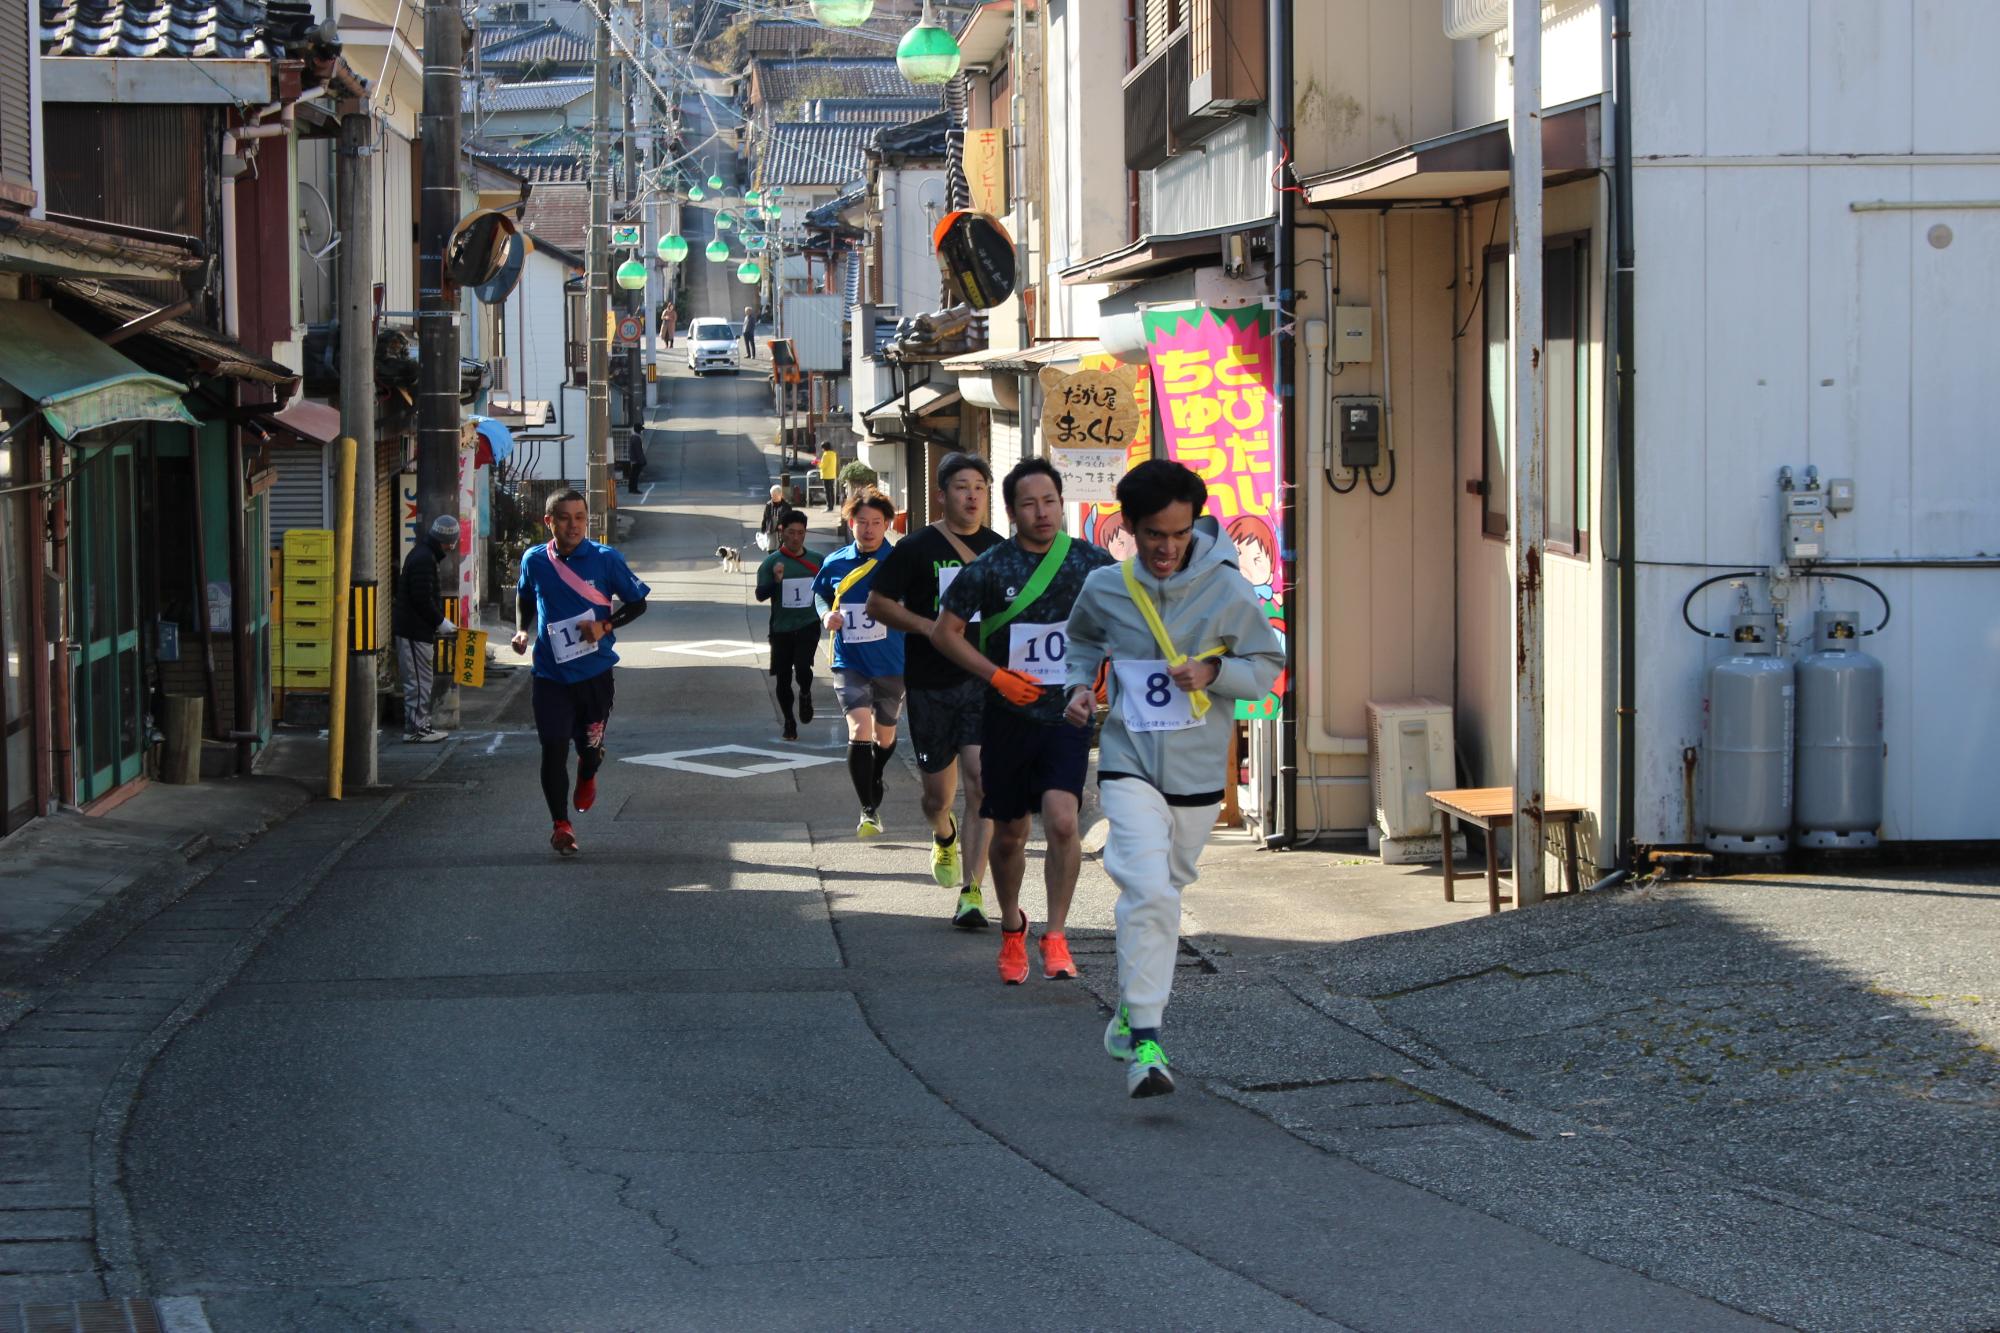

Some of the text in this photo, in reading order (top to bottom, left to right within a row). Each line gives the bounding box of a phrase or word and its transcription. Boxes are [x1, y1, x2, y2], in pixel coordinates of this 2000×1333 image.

[623, 323, 636, 336] 30
[1062, 383, 1118, 411] だがし屋
[1056, 409, 1125, 445] まっくん
[1214, 345, 1274, 517] とびだし
[1062, 472, 1117, 484] やってます
[793, 587, 802, 602] 1
[462, 630, 478, 683] 交通安全
[1024, 631, 1066, 662] 10
[1145, 672, 1171, 708] 8
